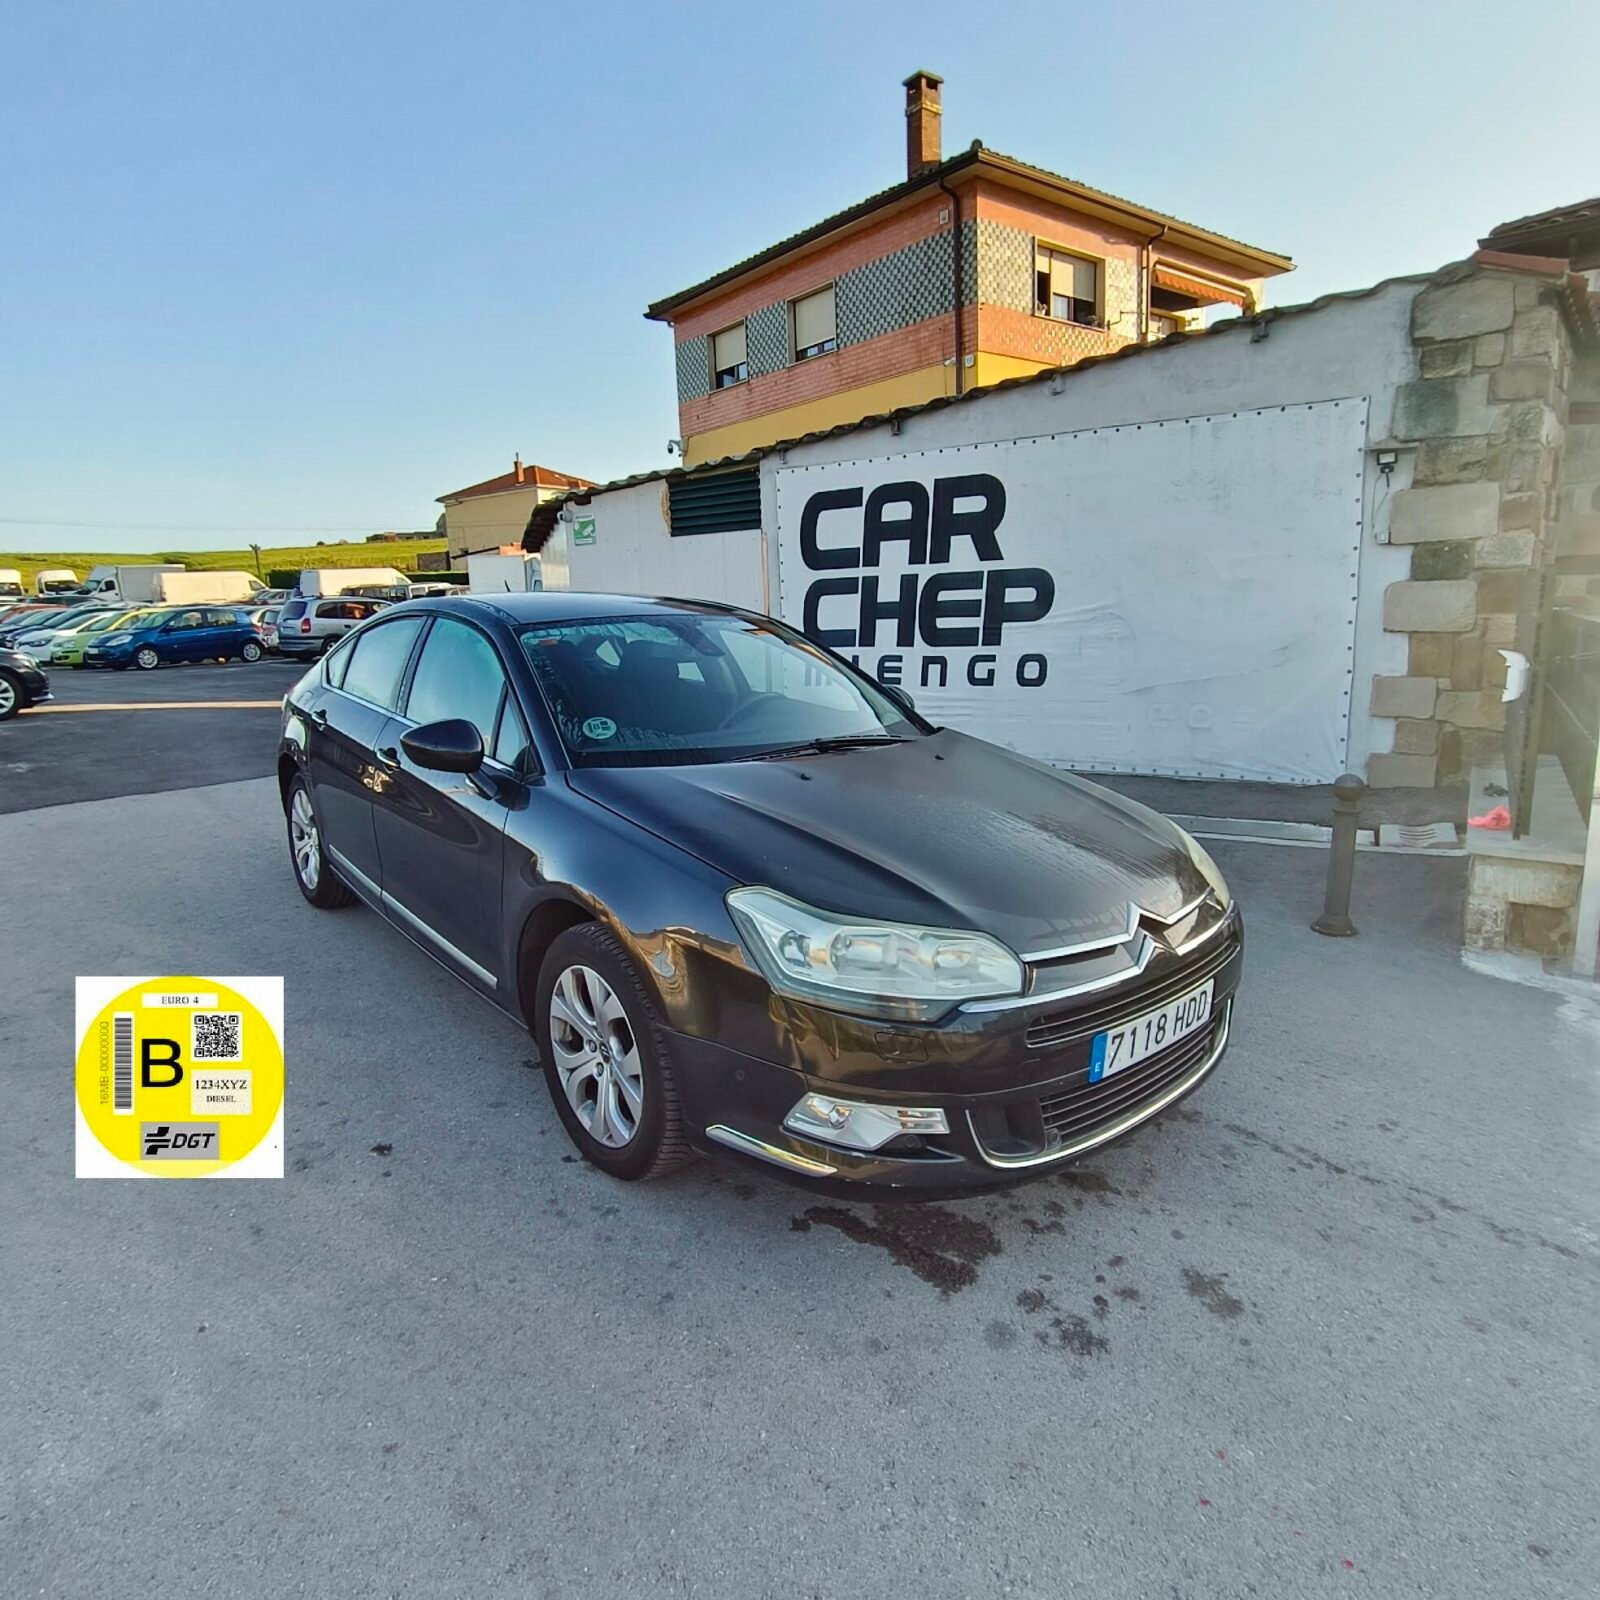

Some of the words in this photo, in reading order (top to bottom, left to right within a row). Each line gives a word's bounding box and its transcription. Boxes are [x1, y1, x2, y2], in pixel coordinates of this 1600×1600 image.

[800, 473, 1006, 571] CAR
[803, 567, 1055, 647] CHEP
[1094, 1061, 1101, 1073] E
[1109, 1013, 1167, 1068] 7118
[1173, 990, 1207, 1035] HDD
